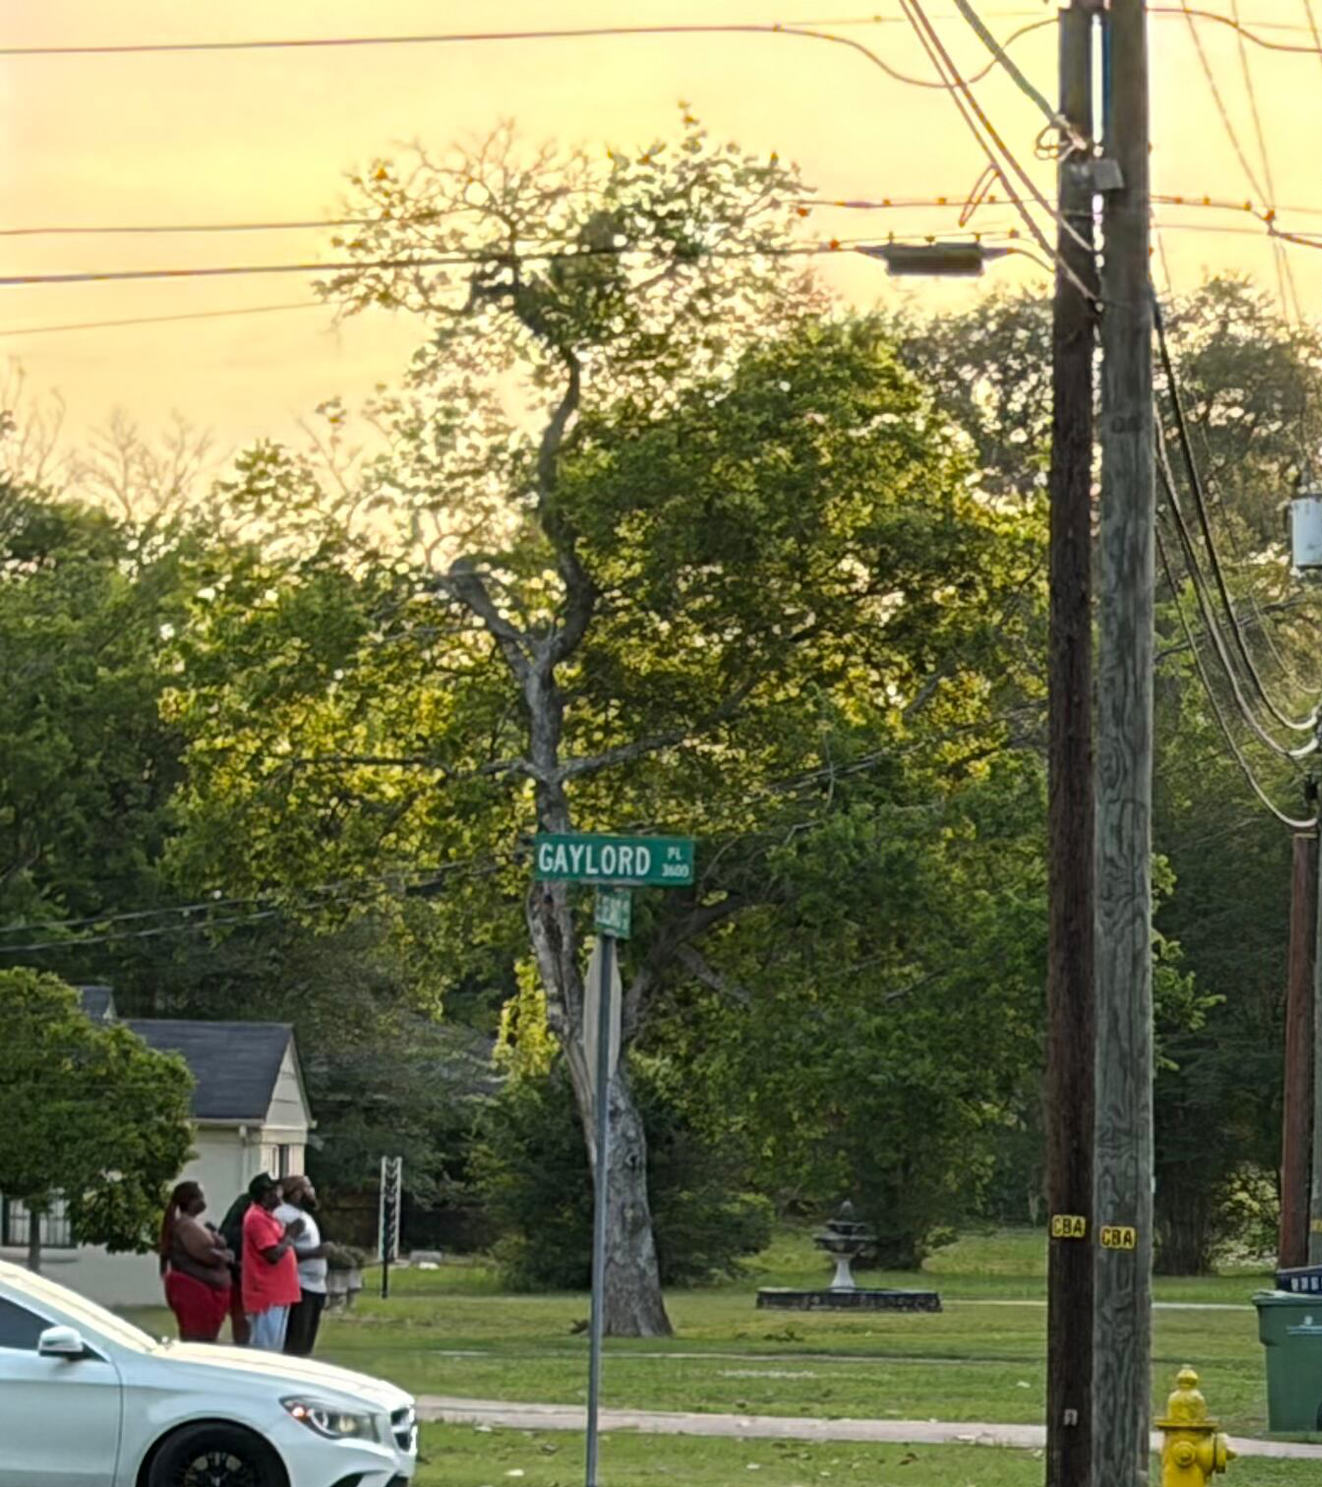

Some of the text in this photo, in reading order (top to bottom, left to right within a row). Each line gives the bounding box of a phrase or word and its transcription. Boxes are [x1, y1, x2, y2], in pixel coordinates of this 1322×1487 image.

[539, 843, 651, 875] GAYLORD
[667, 847, 682, 860] PL
[1053, 1218, 1082, 1235] CBA
[1102, 1229, 1132, 1245] CBA
